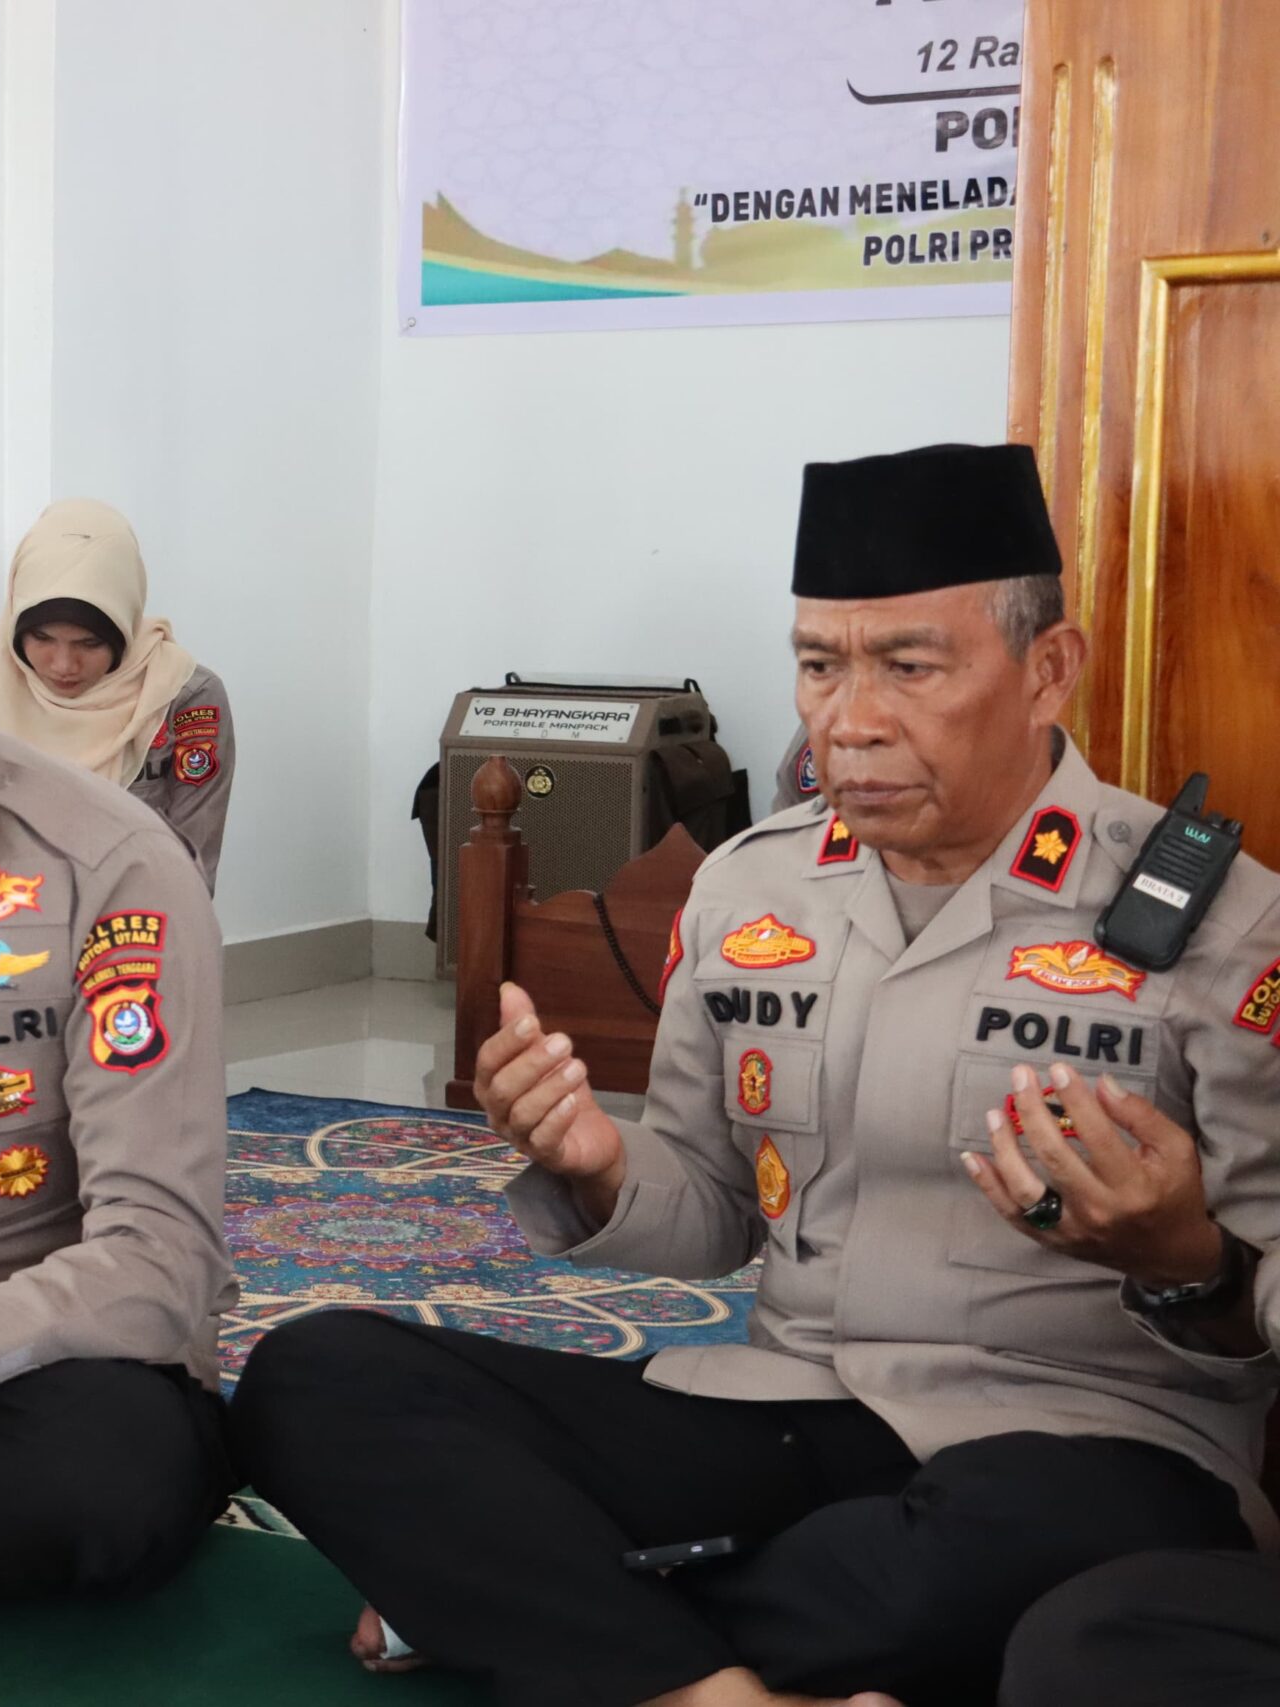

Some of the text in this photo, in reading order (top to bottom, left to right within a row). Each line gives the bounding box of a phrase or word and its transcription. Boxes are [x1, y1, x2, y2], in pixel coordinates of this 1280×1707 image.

[917, 36, 1021, 73] 12 Ra
[863, 231, 960, 266] POLRI
[474, 706, 630, 722] V8 BHAYANGKARA
[483, 719, 608, 731] PORTABLE MANPACK
[1140, 877, 1175, 900] BRATA
[975, 1006, 1144, 1066] POLRI
